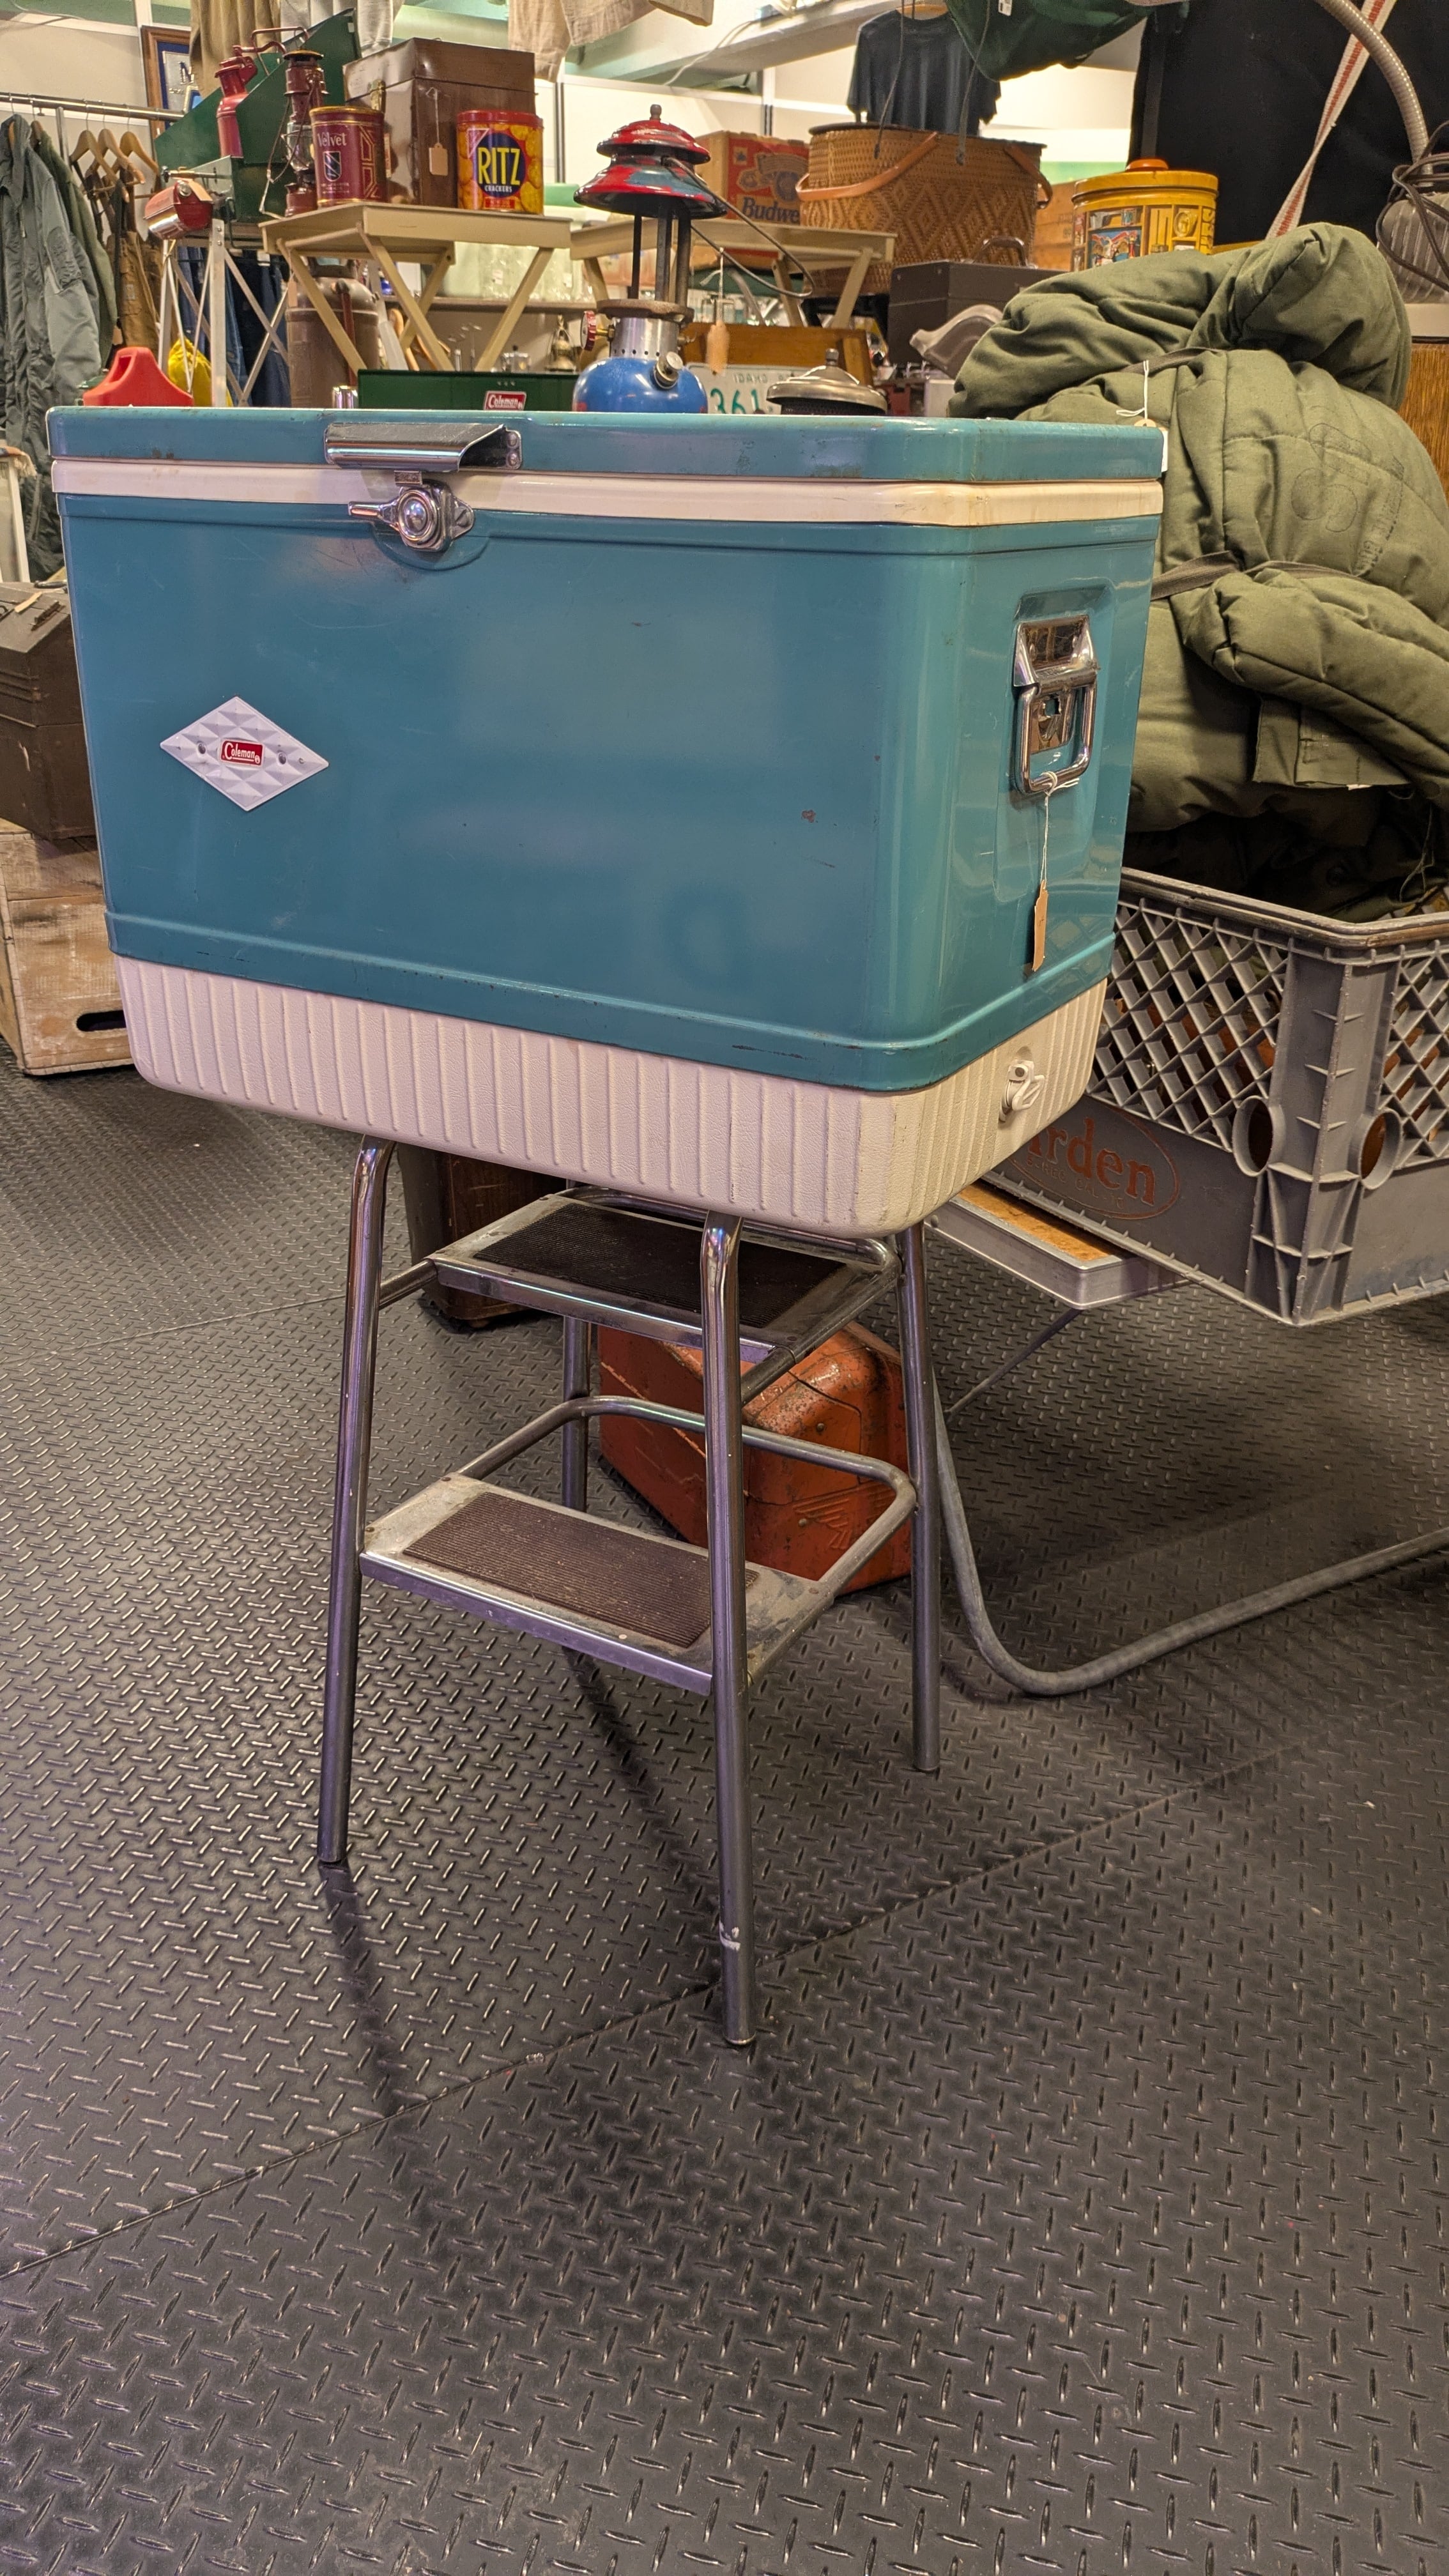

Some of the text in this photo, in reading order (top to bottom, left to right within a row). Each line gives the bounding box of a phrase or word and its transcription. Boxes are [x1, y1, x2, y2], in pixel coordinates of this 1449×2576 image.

[318, 132, 348, 147] Velvet
[477, 147, 521, 185] RITZ
[484, 185, 512, 193] CRACKERS
[732, 372, 768, 384] IDAHO
[487, 394, 519, 409] Coleman
[224, 742, 256, 760] Coleman
